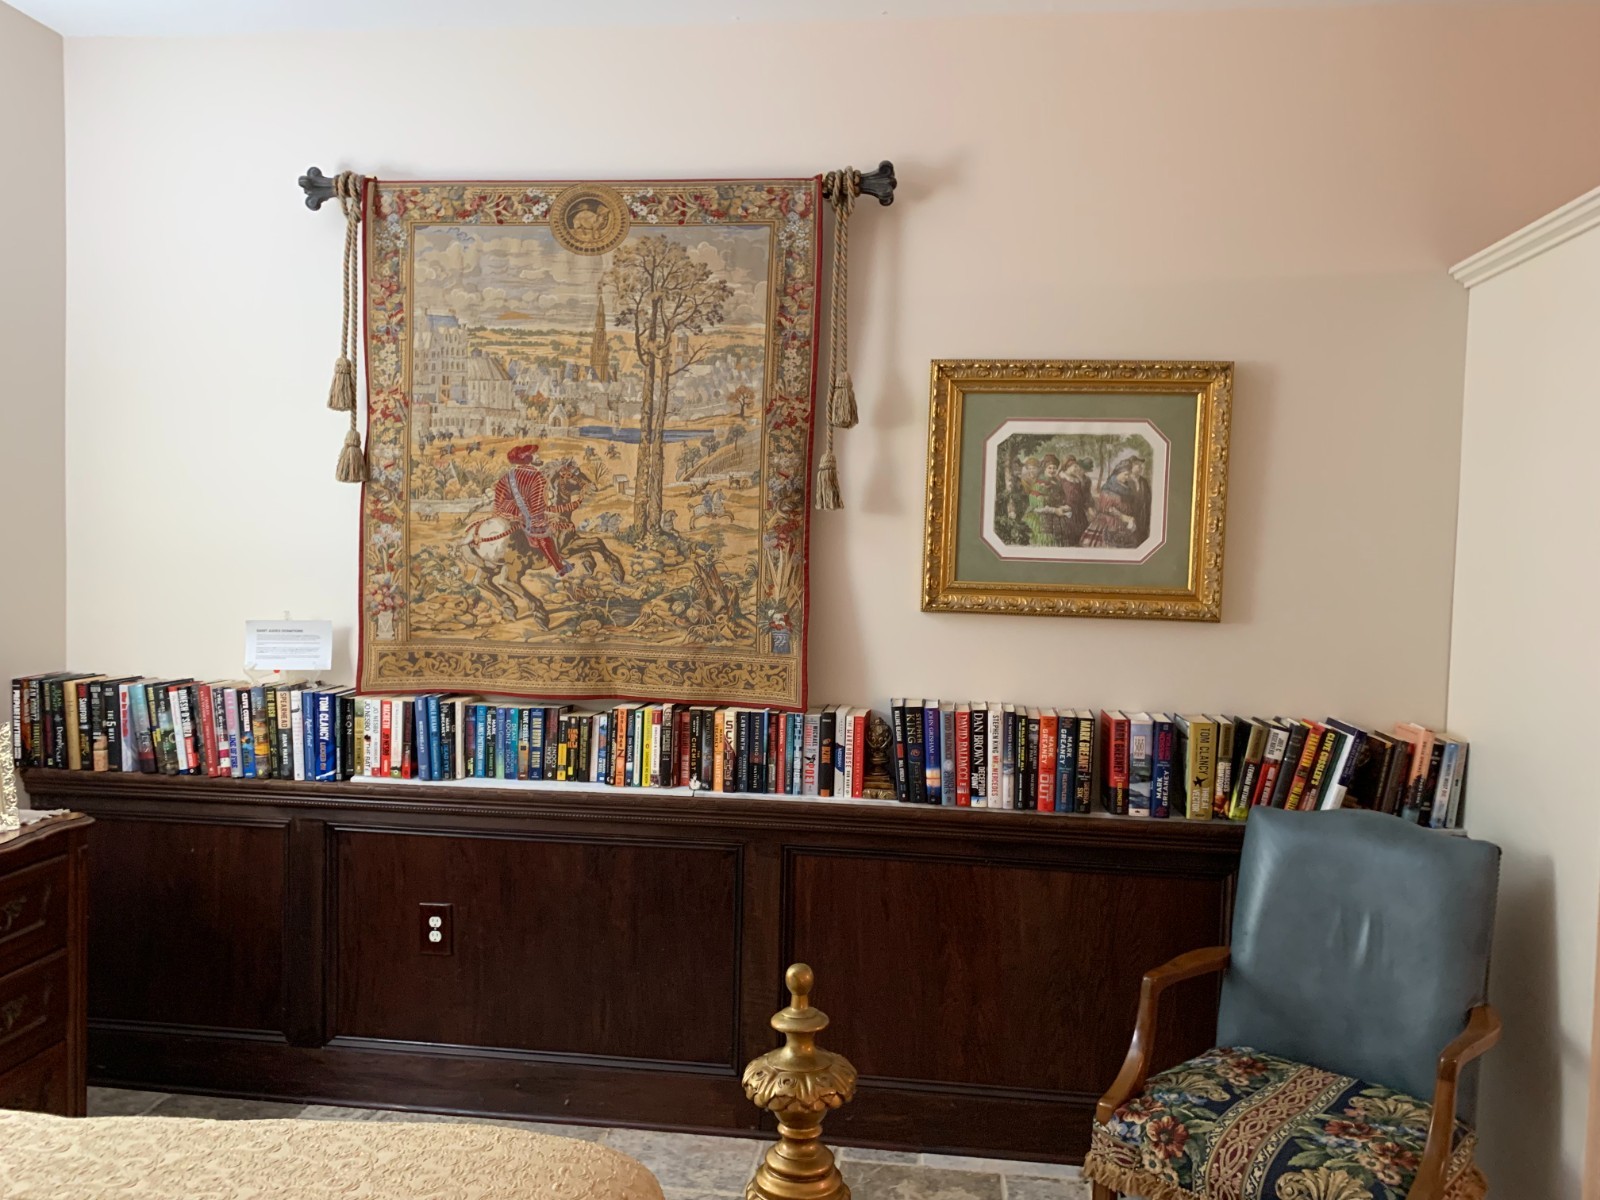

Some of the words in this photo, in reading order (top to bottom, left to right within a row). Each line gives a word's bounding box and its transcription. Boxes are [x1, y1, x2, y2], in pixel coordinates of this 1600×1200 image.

[179, 690, 190, 711] DINESH
[267, 691, 275, 701] THE
[320, 697, 329, 711] TOM
[365, 701, 370, 710] JO
[280, 693, 288, 728] SPEARHEAD
[373, 706, 379, 714] JO
[182, 713, 192, 737] D'SOUZA
[320, 713, 329, 740] CLANCY
[533, 718, 541, 728] DAN
[907, 714, 916, 744] KING
[959, 715, 968, 739] DAVID
[974, 713, 984, 732] DAN
[1080, 720, 1091, 740] MARK
[1116, 722, 1126, 741] MARK
[383, 732, 390, 740] JO
[533, 729, 541, 747] BROWN
[1200, 728, 1211, 743] TOM
[1322, 732, 1336, 751] CLIVE
[532, 751, 541, 768] ORIGIN
[960, 741, 968, 780] BALDACCI
[974, 735, 984, 765] BROWN
[1078, 742, 1090, 772] GREANEY
[1114, 744, 1125, 774] GREANEY
[1199, 746, 1209, 776] CLANCY
[1301, 733, 1320, 767] CHAMELEON
[805, 763, 815, 785] POET
[1217, 762, 1225, 796] COUNTDOWN
[1244, 766, 1255, 785] TEHRAN
[1311, 751, 1329, 785] CUSSLER'S
[971, 773, 979, 789] POINT
[1039, 774, 1049, 801] OUT
[1192, 789, 1201, 812] VECTOR
[1202, 787, 1210, 810] THREAT
